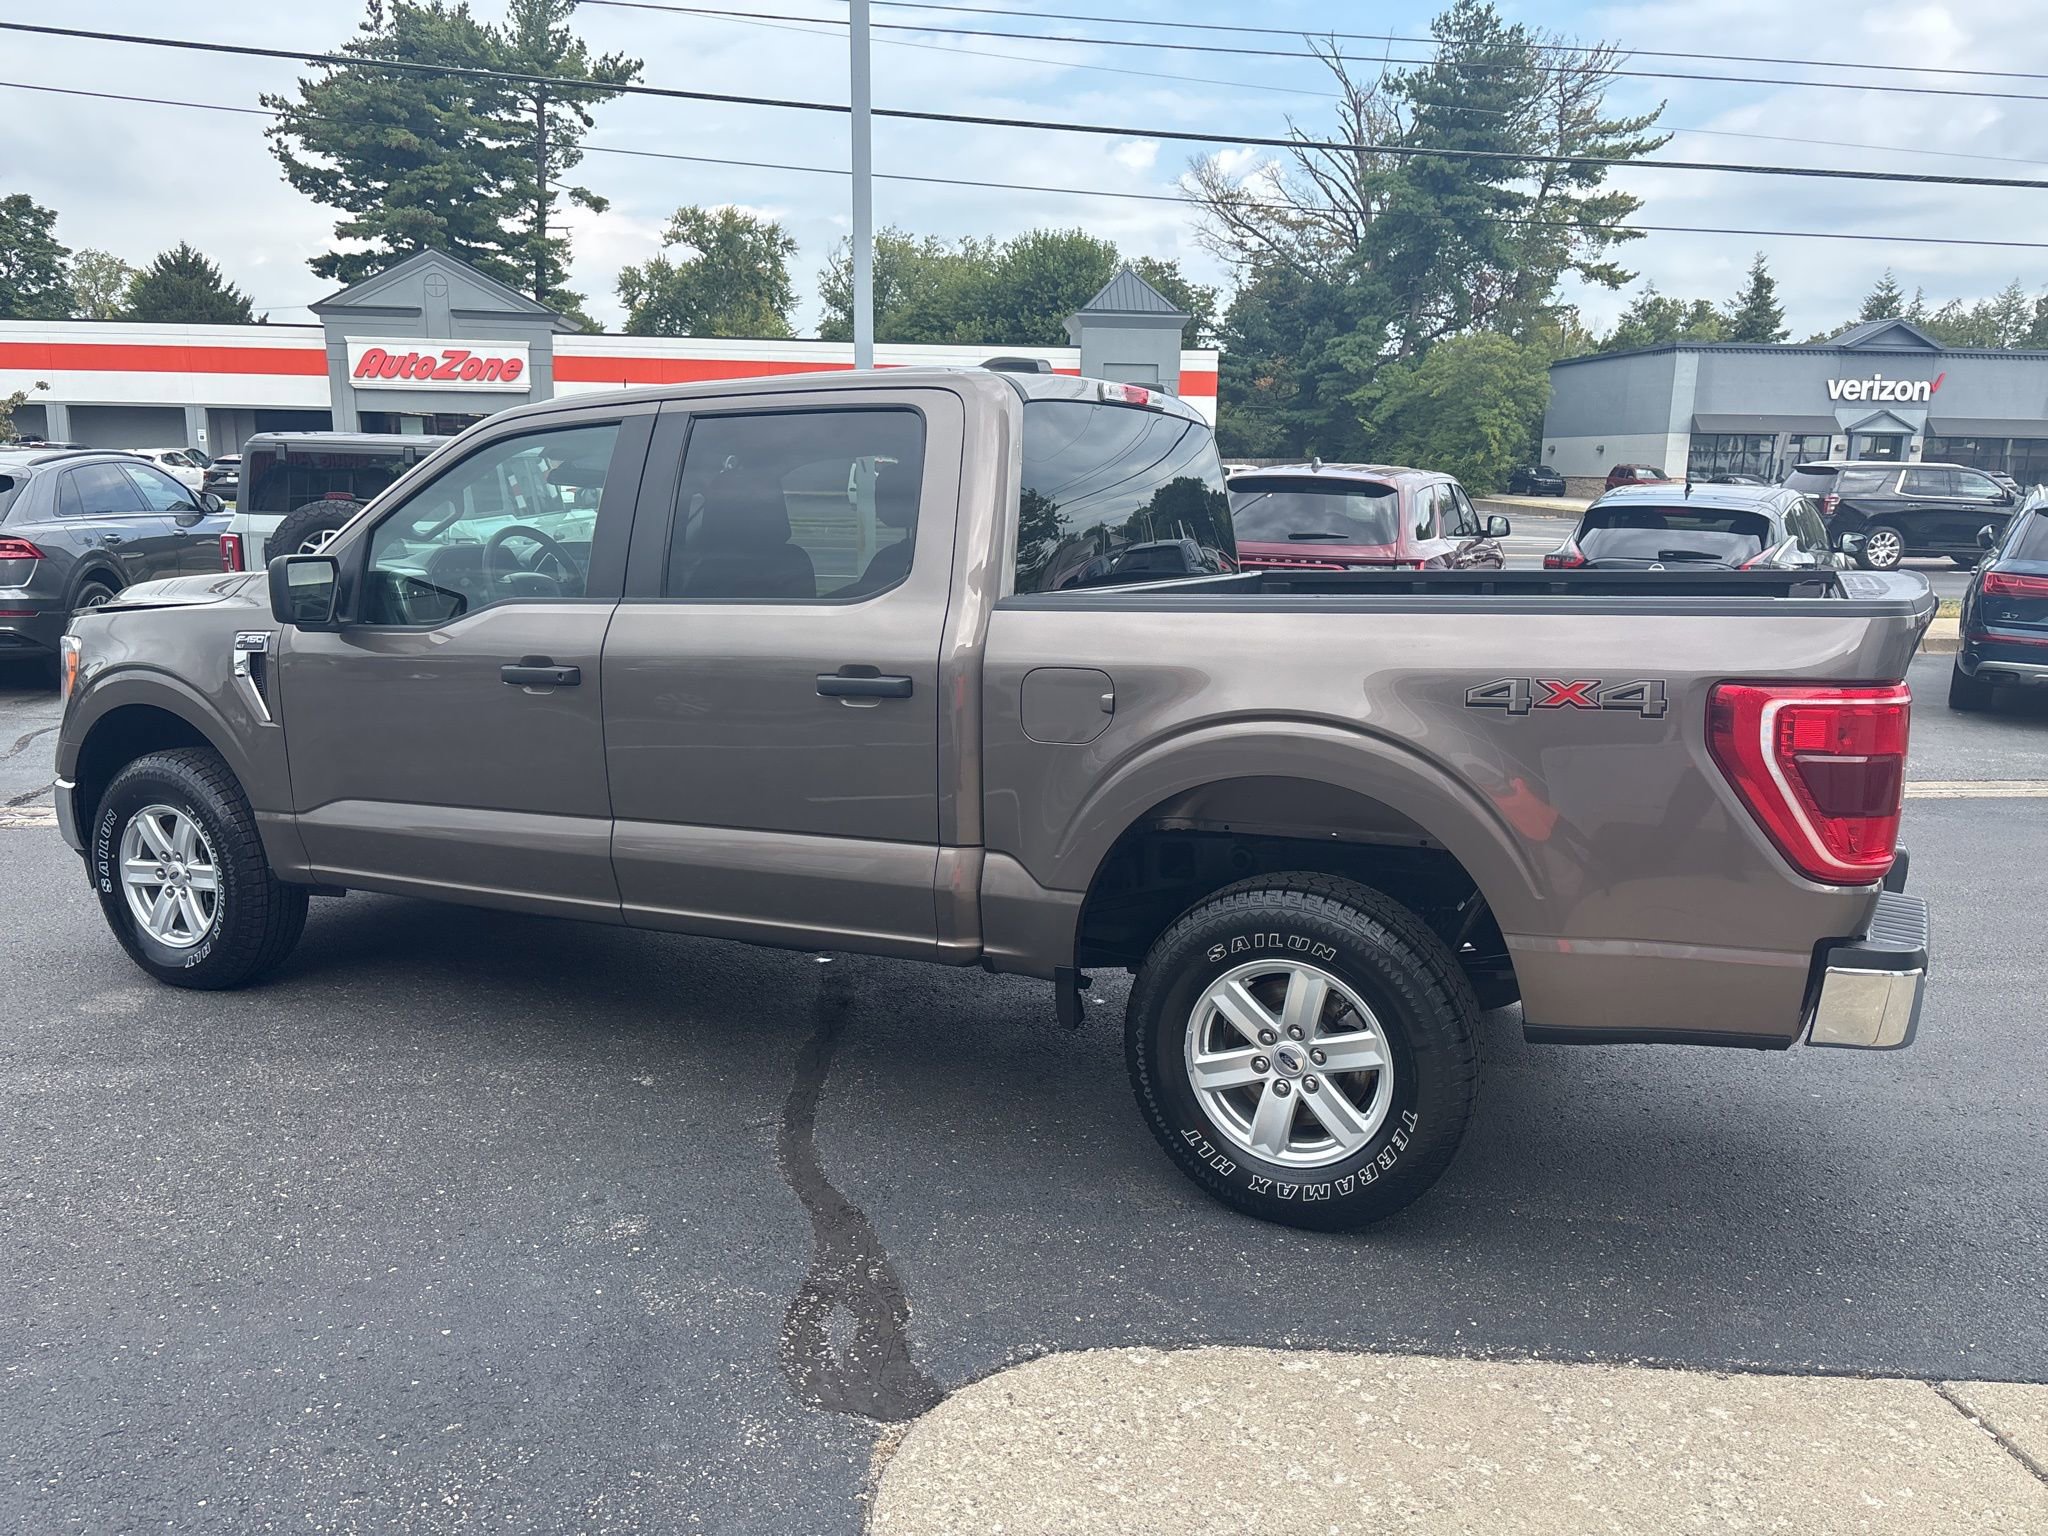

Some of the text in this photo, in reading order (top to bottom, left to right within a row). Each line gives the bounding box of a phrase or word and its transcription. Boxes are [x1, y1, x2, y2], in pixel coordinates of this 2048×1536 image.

[353, 347, 524, 382] AutoZone
[1826, 373, 1931, 402] verizon
[97, 807, 119, 893] SAILUN
[184, 942, 213, 969] HLT
[1207, 932, 1337, 963] SAILUN
[1180, 1108, 1419, 1202] TERRAMAX HLT
